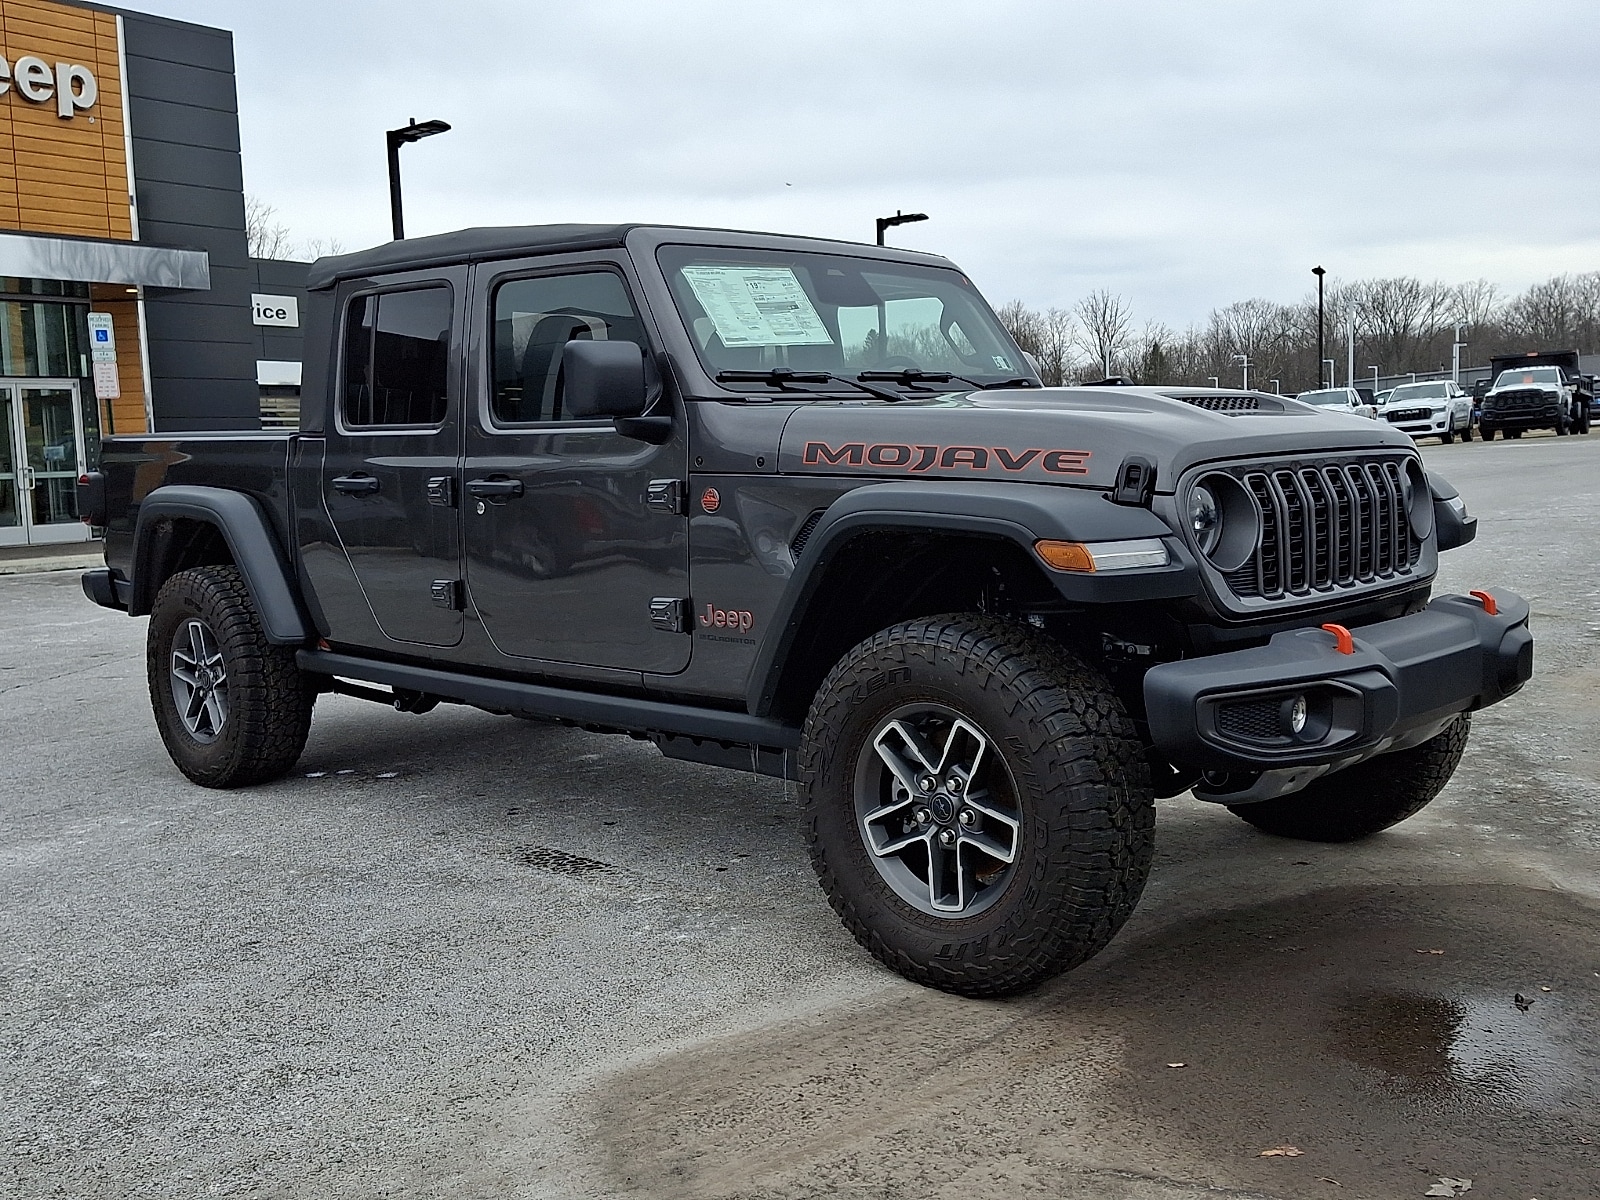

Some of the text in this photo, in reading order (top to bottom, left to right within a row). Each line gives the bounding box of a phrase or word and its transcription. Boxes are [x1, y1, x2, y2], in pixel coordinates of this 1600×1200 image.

[0, 55, 98, 119] ep
[256, 302, 287, 320] ice
[803, 441, 1092, 474] MOJAVE
[699, 603, 754, 634] Jeep
